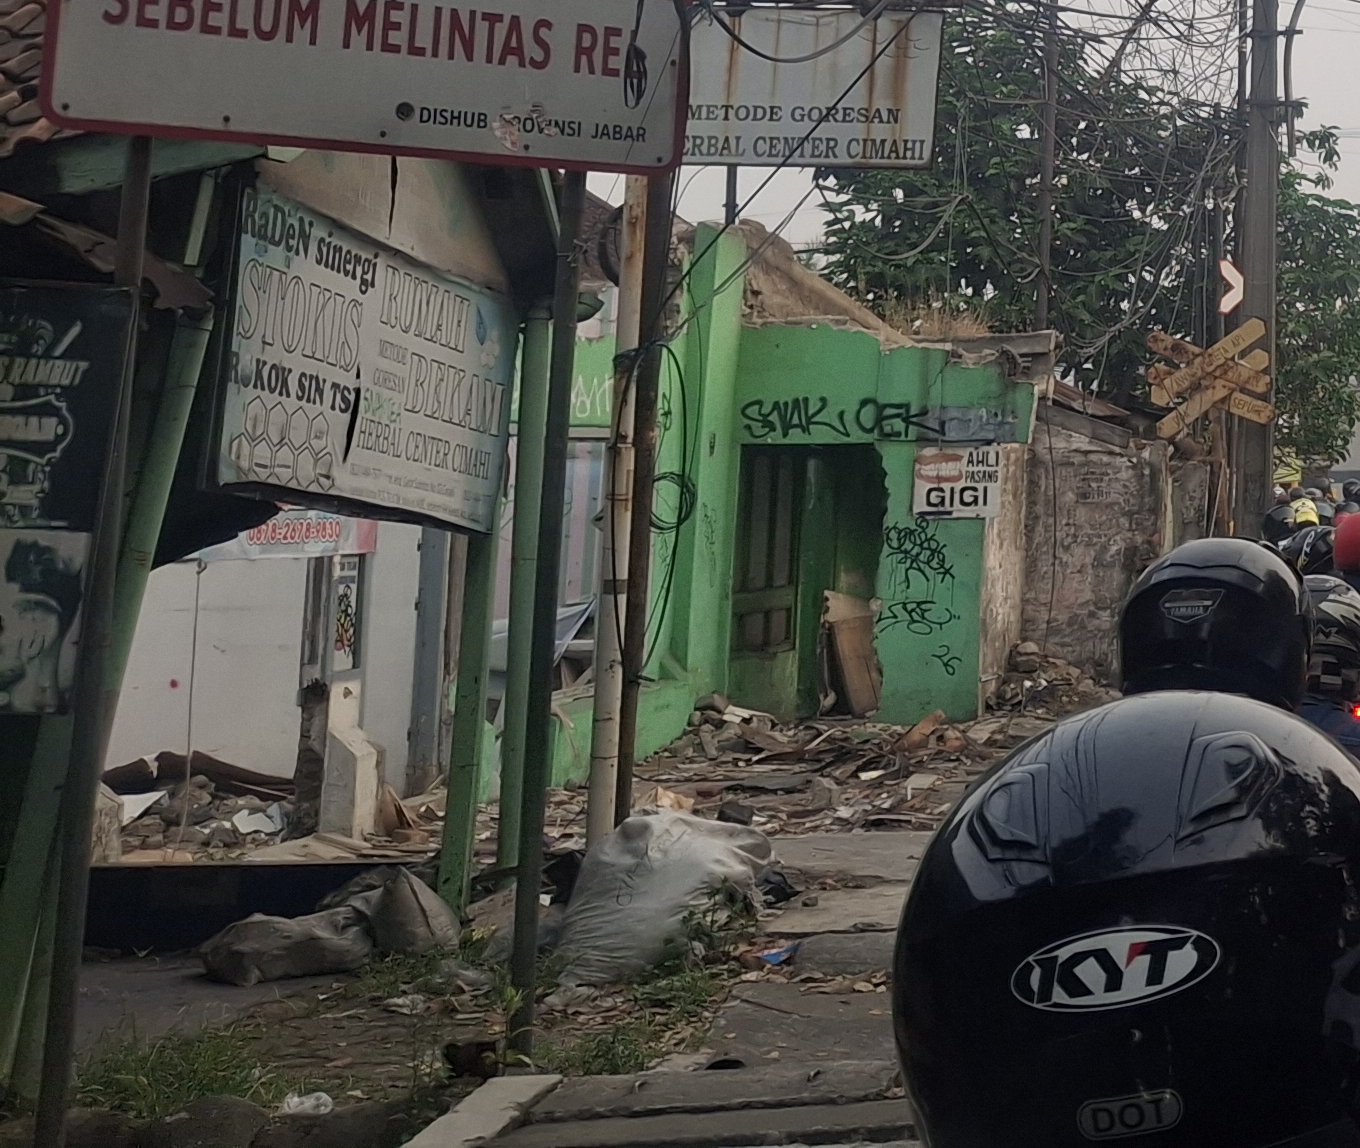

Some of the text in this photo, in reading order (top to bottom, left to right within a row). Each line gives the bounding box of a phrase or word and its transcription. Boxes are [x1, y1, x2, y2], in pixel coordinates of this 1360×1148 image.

[419, 107, 488, 129] DISHUB
[590, 122, 647, 143] JABAR
[687, 104, 901, 125] METODE GORESAN
[752, 135, 840, 160] CENTER
[845, 138, 926, 161] CIMAHI
[315, 230, 381, 295] sinergi
[237, 257, 363, 373] STOKIS
[379, 264, 471, 354] RUMAH
[403, 351, 506, 438] BEKAM
[357, 415, 403, 459] HERBAL
[405, 430, 451, 469] CENTER
[452, 443, 492, 481] CIMAHI
[966, 450, 999, 468] AHLI
[965, 469, 999, 484] PASANG
[925, 485, 988, 508] GIGI
[1031, 933, 1198, 1004] KYT
[1091, 1098, 1164, 1134] DOT
